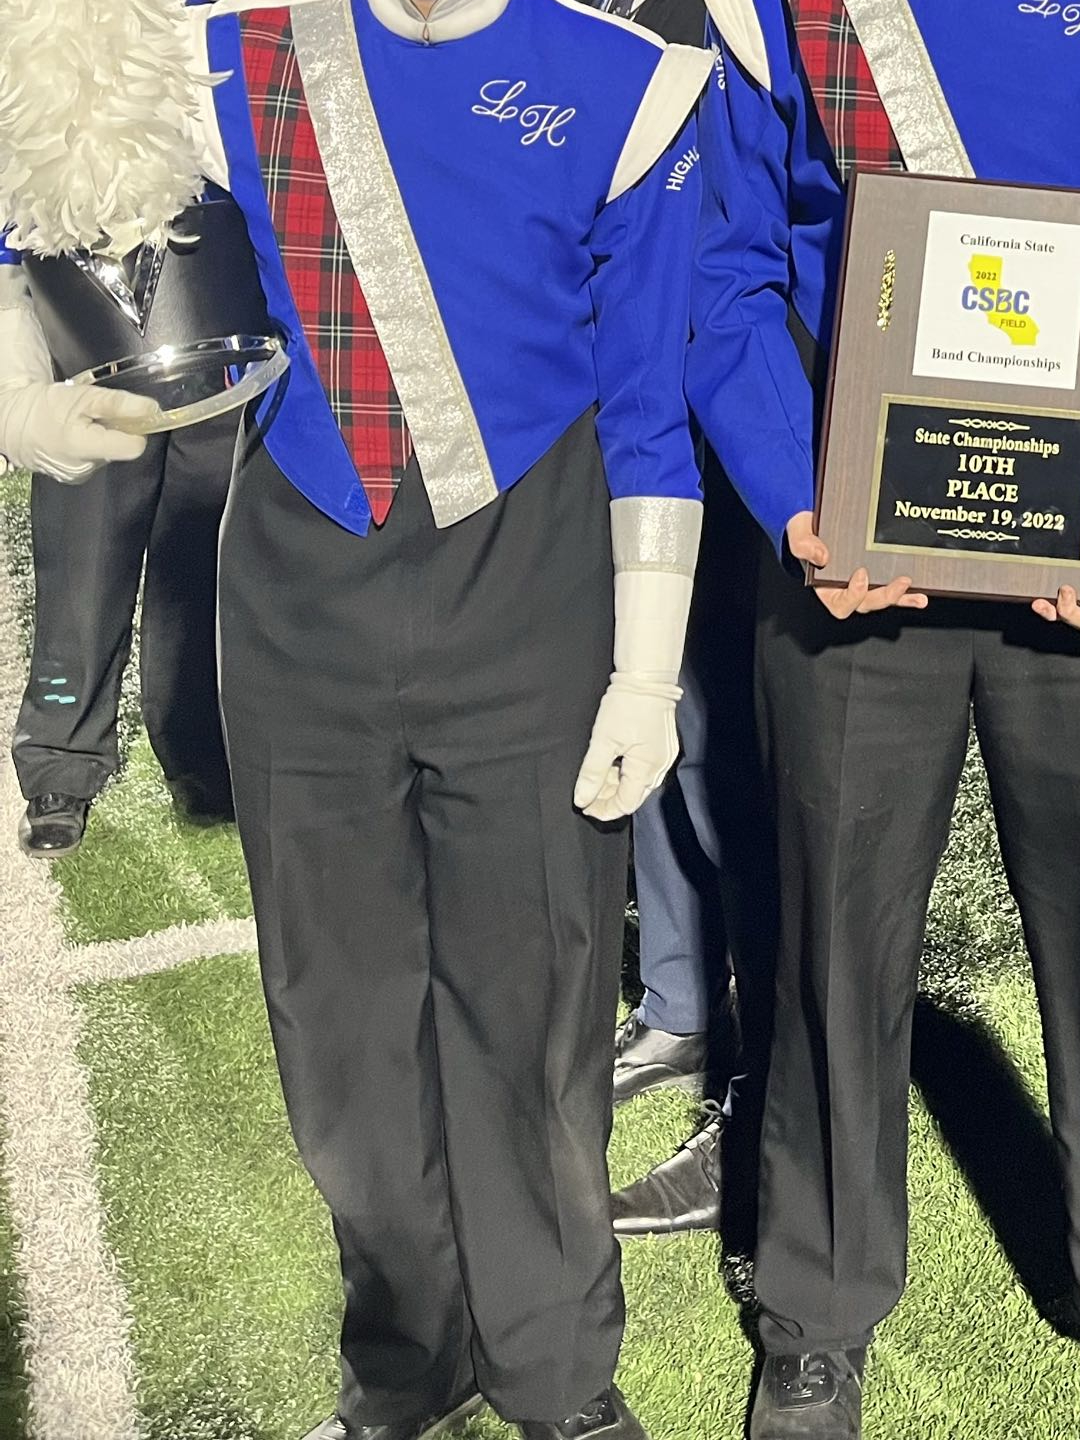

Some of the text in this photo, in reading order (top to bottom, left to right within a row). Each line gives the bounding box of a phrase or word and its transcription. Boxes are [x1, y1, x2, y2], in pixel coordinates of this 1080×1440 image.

[960, 233, 1055, 253] California State
[975, 270, 997, 281] 2022
[961, 285, 1030, 315] CSBC
[1000, 318, 1027, 329] FIELD
[932, 347, 1061, 372] Band Championships
[915, 427, 1060, 458] State Championships
[957, 453, 1016, 476] 10TH
[946, 479, 1019, 503] PLACE
[894, 500, 1066, 531] November 19, 2022
